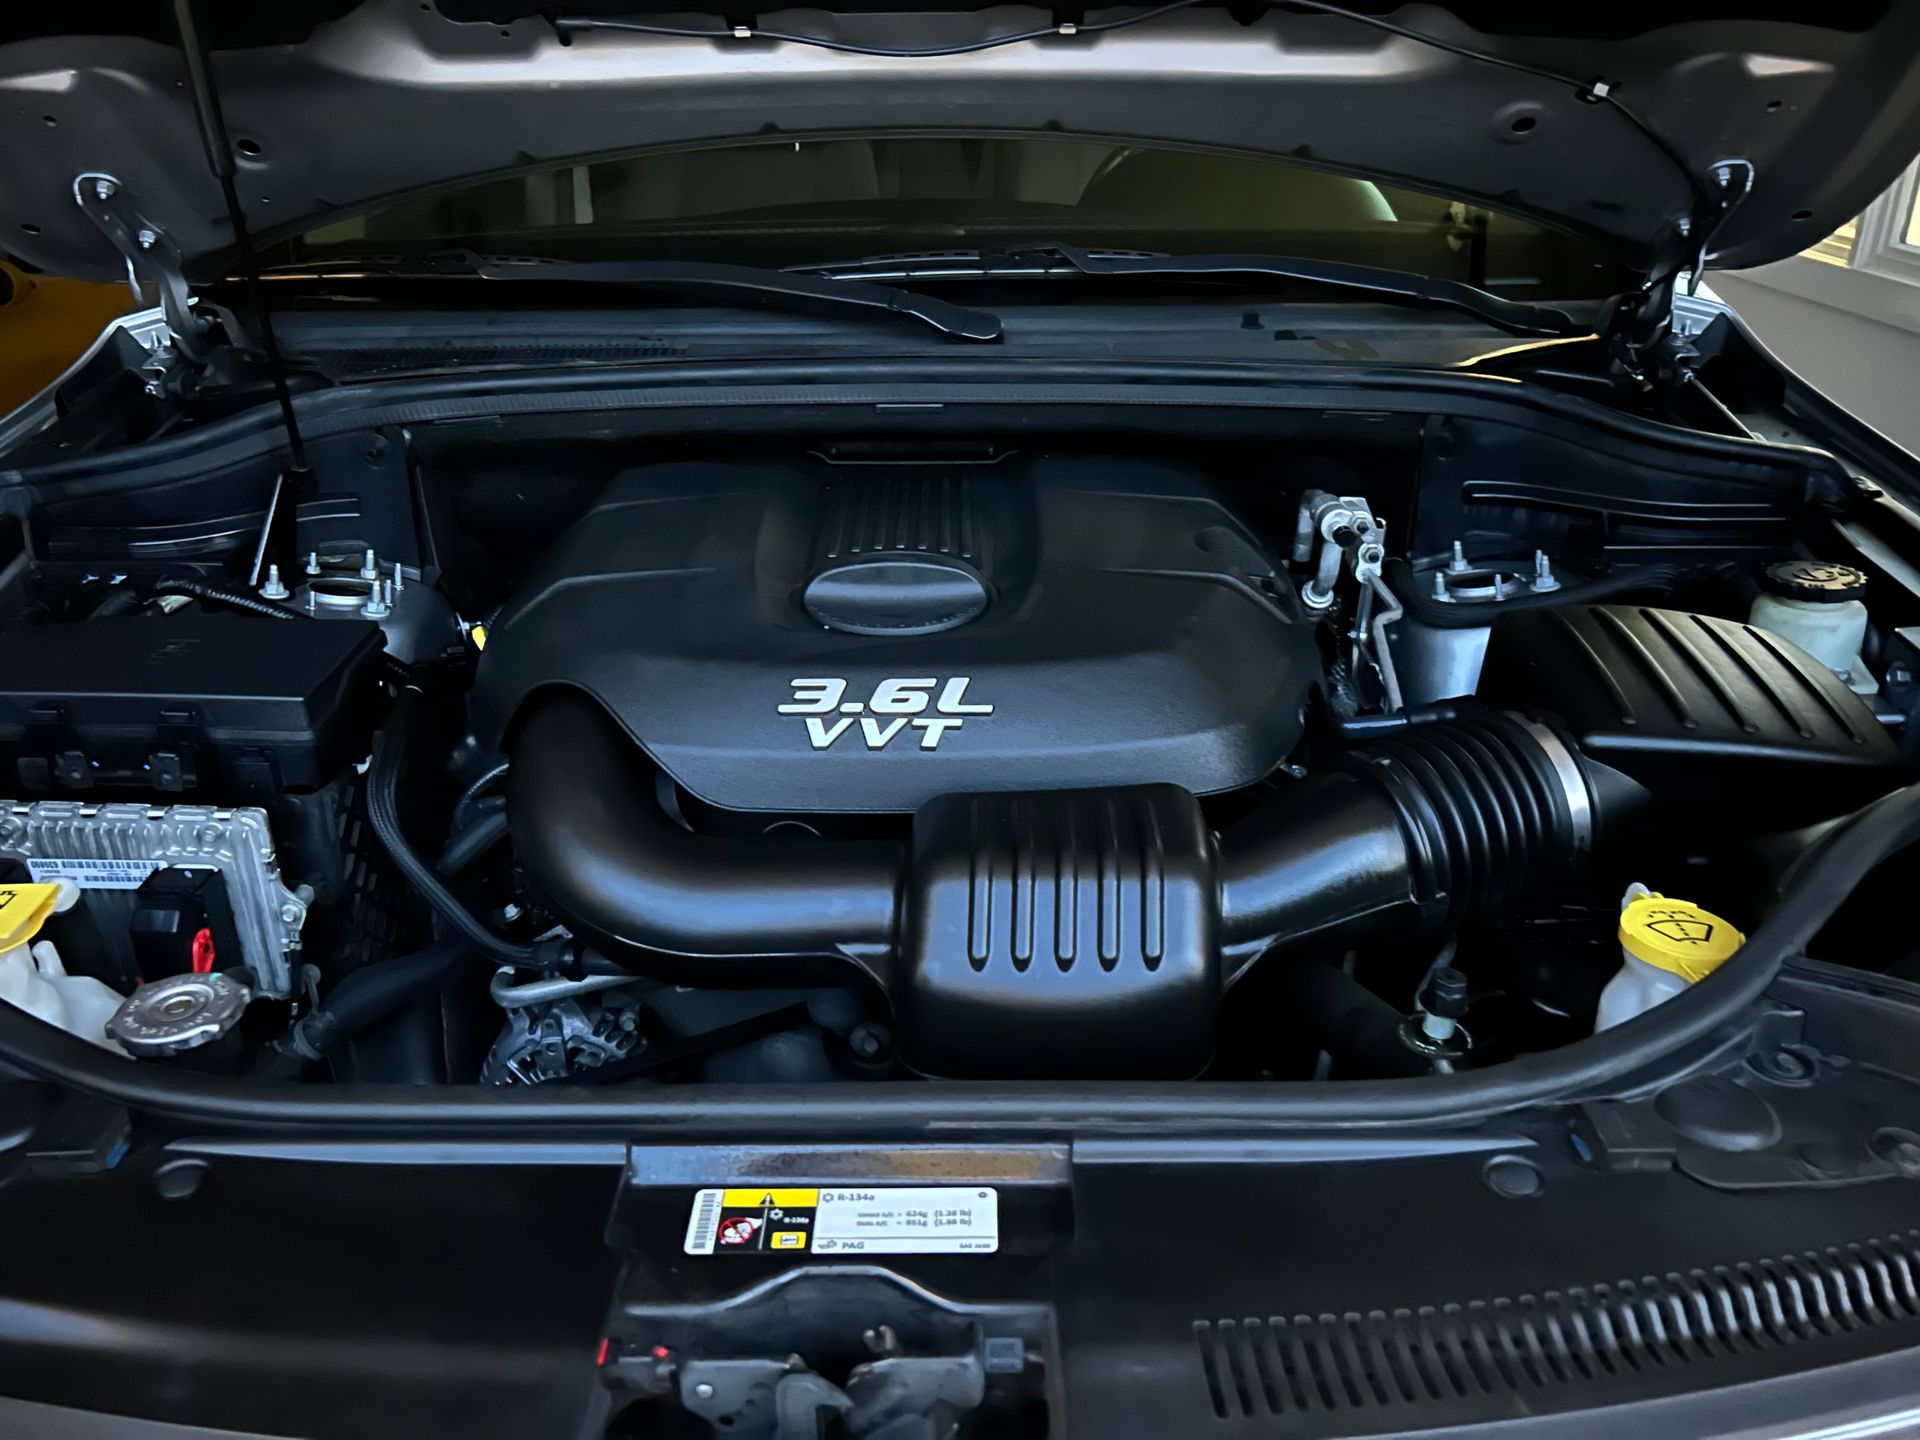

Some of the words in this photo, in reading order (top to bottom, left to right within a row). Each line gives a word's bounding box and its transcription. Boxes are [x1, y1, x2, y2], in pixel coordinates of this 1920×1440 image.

[777, 677, 994, 714] 3.6L
[805, 717, 963, 750] VVT
[837, 1193, 875, 1202] R-134a
[905, 1210, 928, 1219] 624g
[842, 1241, 865, 1250] PAG
